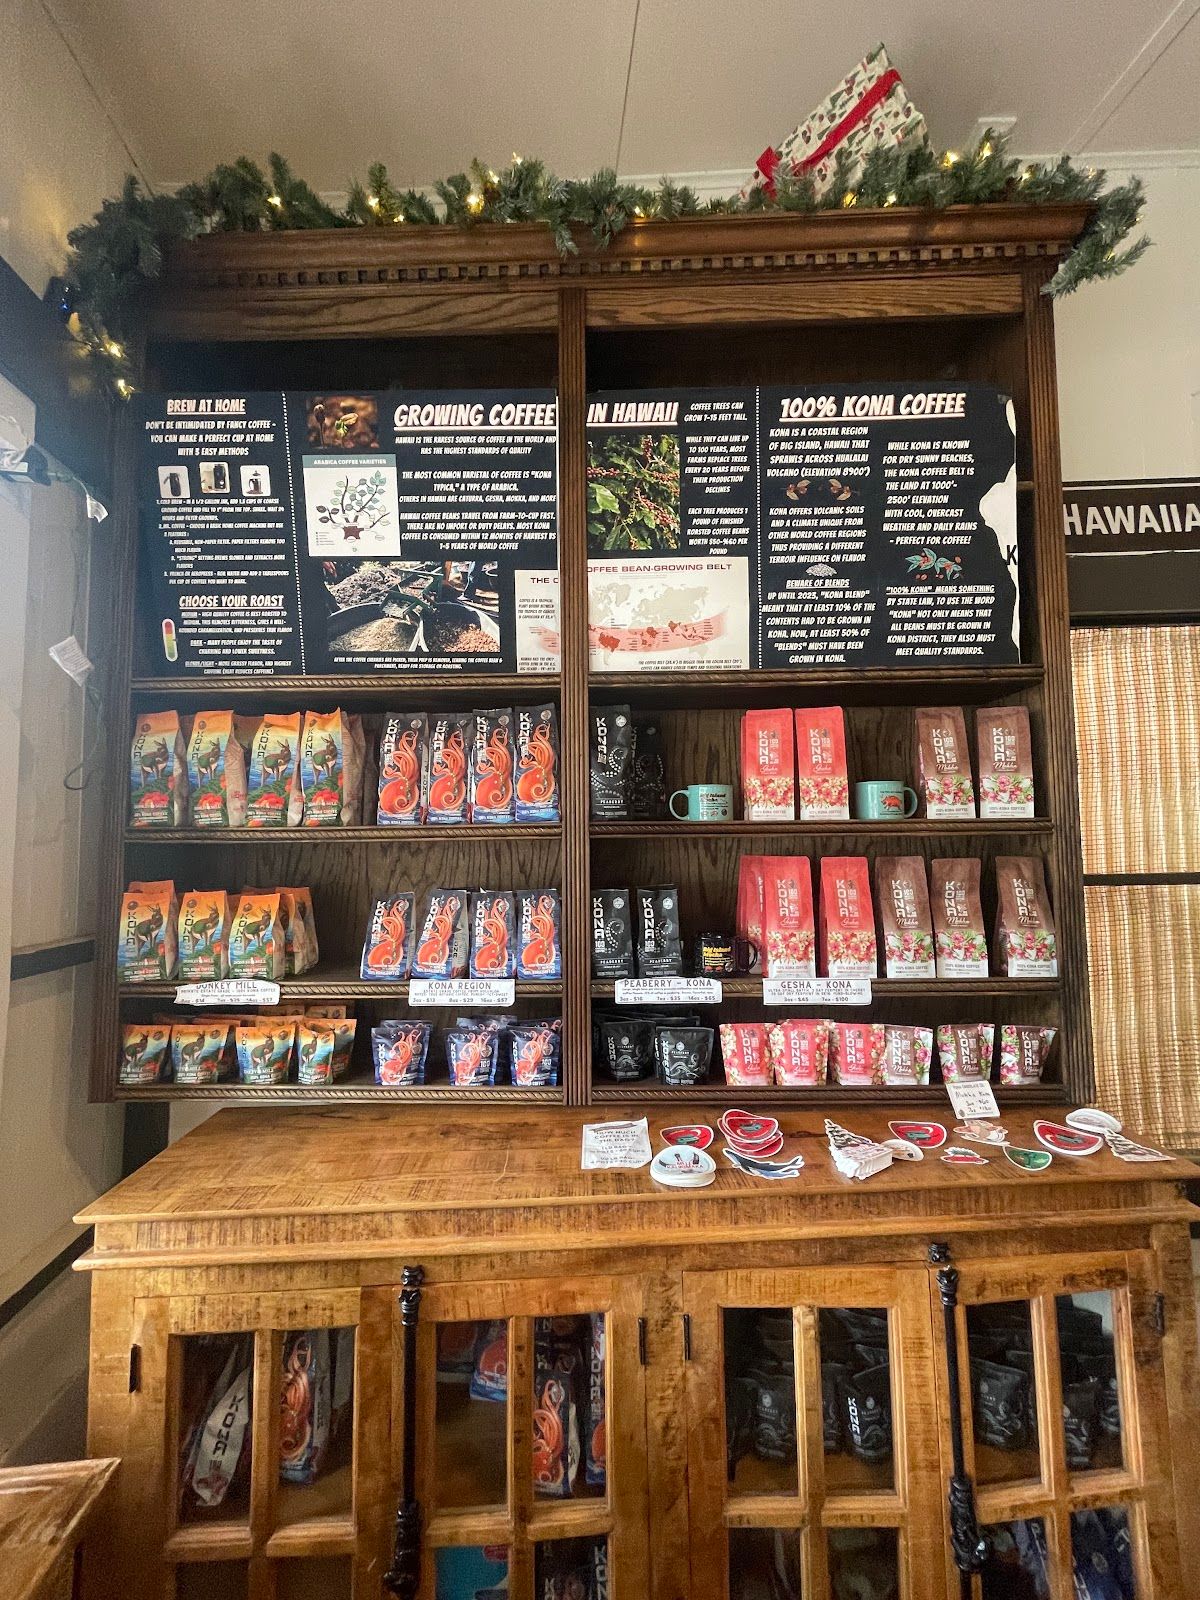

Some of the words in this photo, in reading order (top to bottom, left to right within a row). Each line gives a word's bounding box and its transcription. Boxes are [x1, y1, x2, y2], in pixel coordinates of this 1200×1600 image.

[166, 399, 196, 412] BREW
[198, 399, 212, 412] AT
[214, 399, 245, 412] HOME
[393, 404, 484, 426] GROWING
[488, 404, 557, 426] COFFEE
[586, 403, 608, 423] IN
[611, 402, 679, 423] HAWAII
[684, 414, 702, 422] GROW
[712, 402, 730, 410] TREES
[781, 396, 837, 418] 100%
[842, 394, 894, 416] KONA
[900, 392, 966, 414] COFFEE
[146, 421, 164, 429] DON'T
[166, 421, 173, 429] BE
[175, 421, 215, 429] INTIMIDATED
[217, 421, 224, 429] BY
[769, 428, 790, 437] KONA
[791, 428, 799, 436] IS
[800, 428, 806, 436] A
[807, 427, 839, 436] COASTAL
[840, 427, 868, 435] REGION
[177, 448, 193, 456] WITH
[201, 448, 217, 456] EASY
[218, 448, 248, 456] METHODS
[768, 442, 778, 451] OF
[780, 442, 793, 450] BIG
[794, 441, 822, 450] ISLAND,
[823, 440, 850, 450] HAWAII
[851, 440, 869, 449] THAT
[769, 455, 803, 464] SPRAWLS
[804, 454, 834, 463] ACROSS
[834, 454, 869, 463] HUALALAI
[882, 456, 897, 464] FOR
[898, 455, 913, 464] DRY
[915, 455, 939, 464] SUNNY
[940, 454, 974, 463] BEACHES,
[887, 442, 908, 450] WHILE
[910, 441, 931, 450] KONA
[932, 441, 940, 449] IS
[942, 440, 969, 449] KNOWN
[402, 471, 413, 479] THE
[413, 471, 432, 479] MOST
[432, 471, 461, 479] COMMON
[462, 471, 489, 479] VARIETAL
[766, 468, 799, 477] VOLCANO
[800, 467, 841, 477] (ELEVATION
[884, 469, 897, 478] THE
[899, 468, 919, 477] KONA
[921, 468, 946, 476] COFFEE
[949, 467, 964, 476] BELT
[967, 467, 974, 475] IS
[885, 482, 899, 490] THE
[899, 482, 919, 490] LAND
[919, 481, 930, 490] AT
[910, 495, 949, 504] ELEVATION
[1063, 504, 1200, 535] HAWAIIA
[895, 536, 925, 545] PERFECT
[925, 536, 941, 545] FOR
[1006, 545, 1018, 565] K
[622, 564, 703, 572] BEAN-GROWING
[814, 579, 823, 587] OF
[179, 596, 218, 607] CHOOSE
[222, 595, 247, 606] YOUR
[250, 595, 283, 606] ROAST
[788, 655, 814, 663] GROWN
[815, 655, 823, 663] IN
[895, 647, 913, 656] MEET
[913, 647, 942, 655] QUALITY
[384, 719, 400, 752] KONA
[434, 720, 447, 750] KONA
[477, 716, 487, 750] KONA
[519, 712, 530, 745] KONA
[759, 730, 768, 765] KONA
[810, 729, 821, 764] KONA
[932, 729, 945, 763] KONA
[993, 728, 1005, 762] KONA
[777, 880, 789, 917] KONA
[836, 880, 848, 917] KONA
[892, 879, 905, 918] KONA
[945, 881, 956, 917] KONA
[1013, 879, 1028, 917] KONA
[372, 901, 386, 932] KONA
[424, 897, 438, 931] KONA
[476, 901, 485, 935] KONA
[522, 898, 532, 931] KONA
[593, 898, 604, 939] KONA
[642, 898, 654, 939] KONA
[686, 979, 712, 987] KONA
[781, 981, 811, 989] GESHA
[607, 1037, 616, 1060] KONA
[740, 1029, 753, 1064] KONA
[791, 1030, 801, 1065] KONA
[845, 1030, 855, 1063] KONA
[892, 1030, 901, 1065] KONA
[958, 1030, 970, 1065] KONA
[1022, 1031, 1032, 1066] KONA
[590, 1346, 601, 1400] KONA
[213, 1395, 244, 1455] KONA
[848, 1396, 860, 1436] KONA
